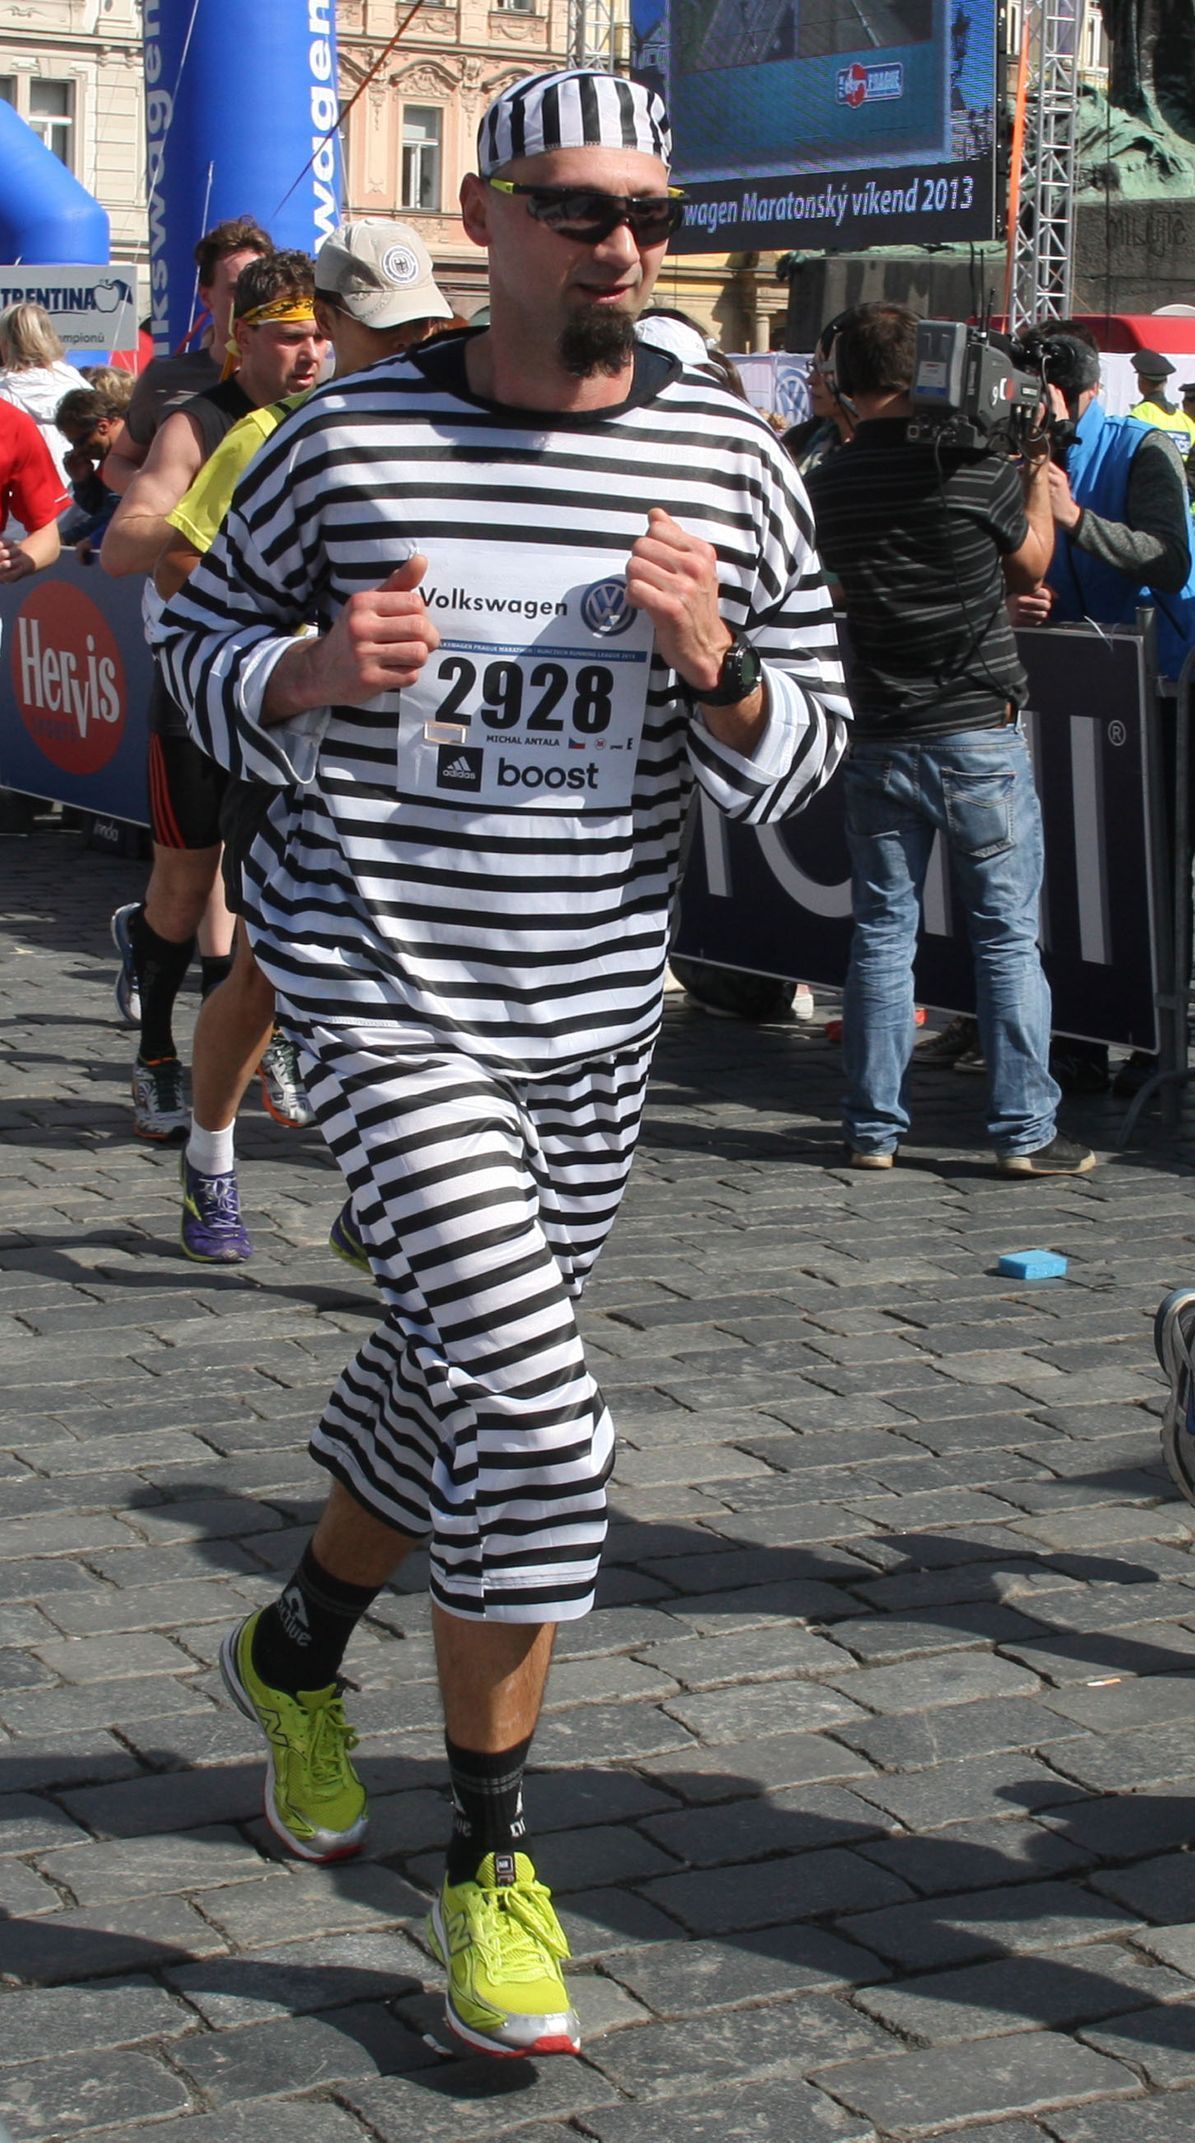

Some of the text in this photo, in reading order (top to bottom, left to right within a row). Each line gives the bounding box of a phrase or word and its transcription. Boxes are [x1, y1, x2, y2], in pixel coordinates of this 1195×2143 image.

[307, 0, 340, 254] wagen
[684, 175, 974, 233] wagen Maratonský víkend 2013
[418, 586, 568, 619] Volkswagen
[18, 616, 120, 738] Hervis
[435, 656, 614, 734] 2928
[486, 735, 560, 747] MICHAL ANTALA
[497, 757, 599, 789] boost
